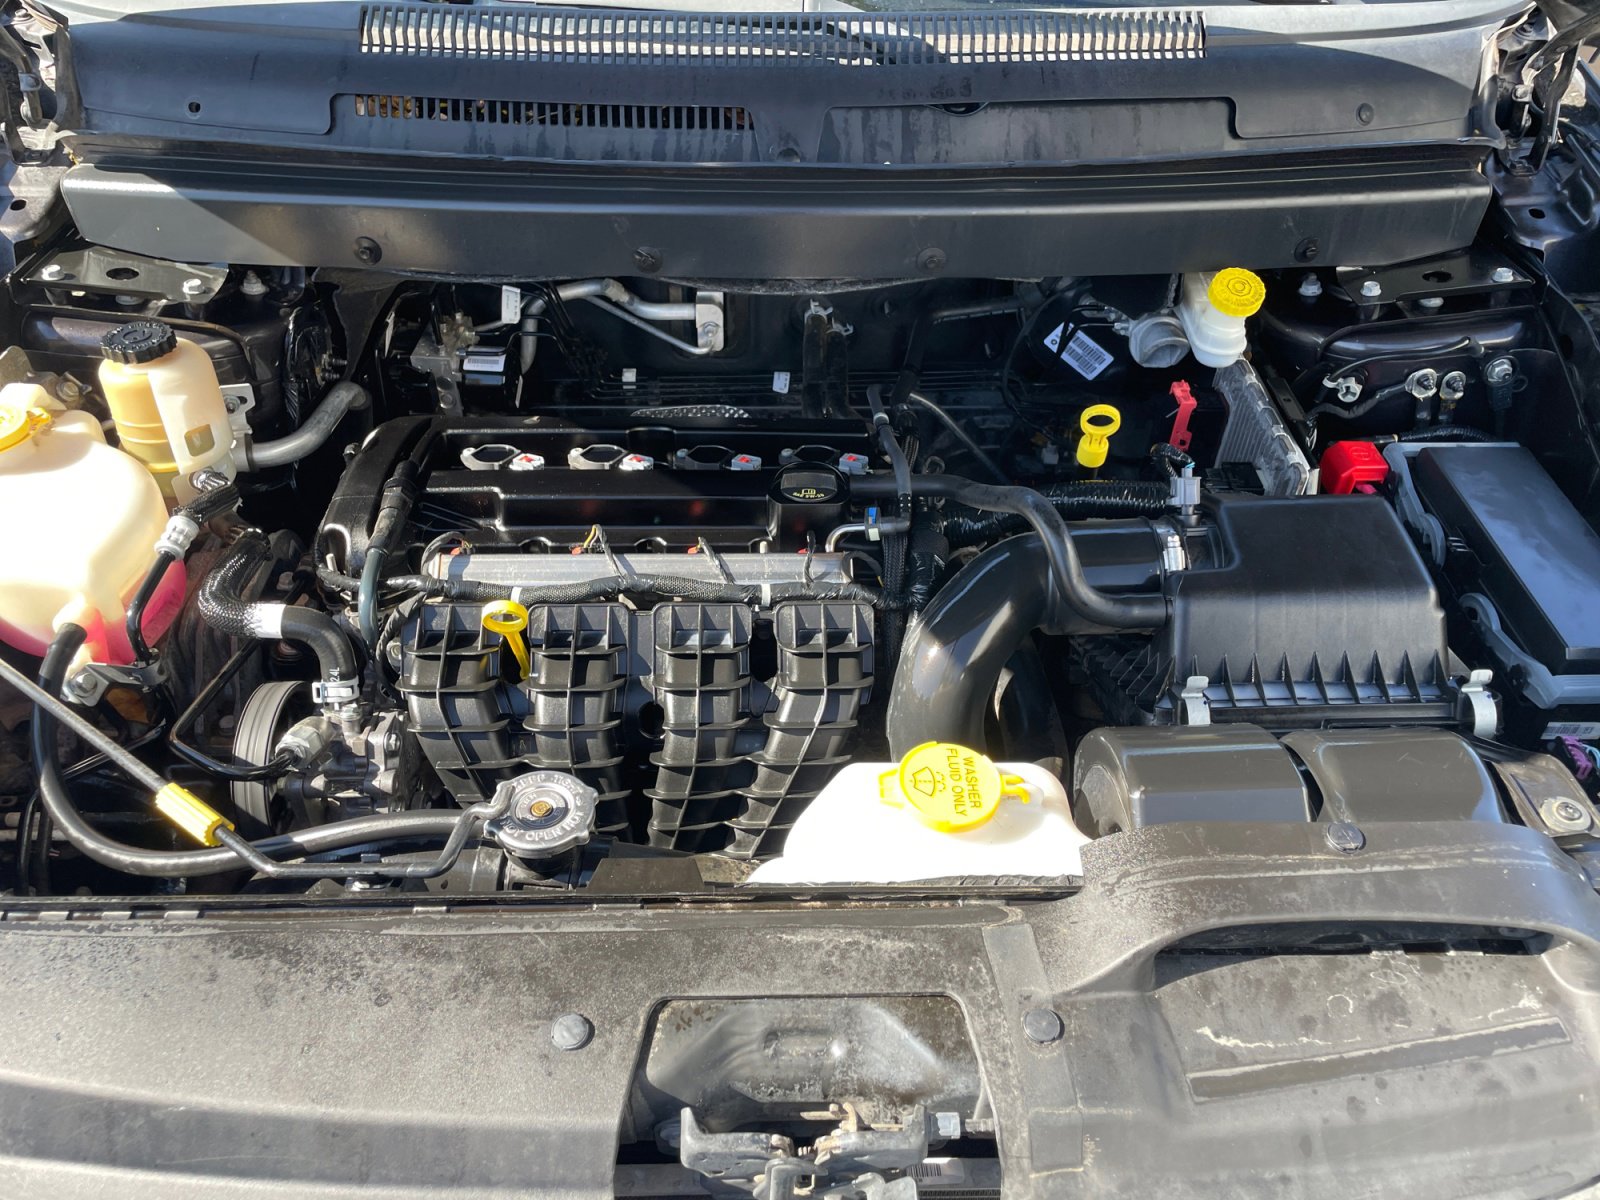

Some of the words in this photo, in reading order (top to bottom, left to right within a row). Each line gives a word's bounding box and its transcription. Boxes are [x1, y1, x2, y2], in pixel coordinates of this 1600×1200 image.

[946, 748, 961, 782] FLUID
[962, 756, 982, 808] WASHER
[951, 786, 967, 816] ONLY
[500, 817, 524, 838] NOT
[525, 828, 565, 841] OPEN
